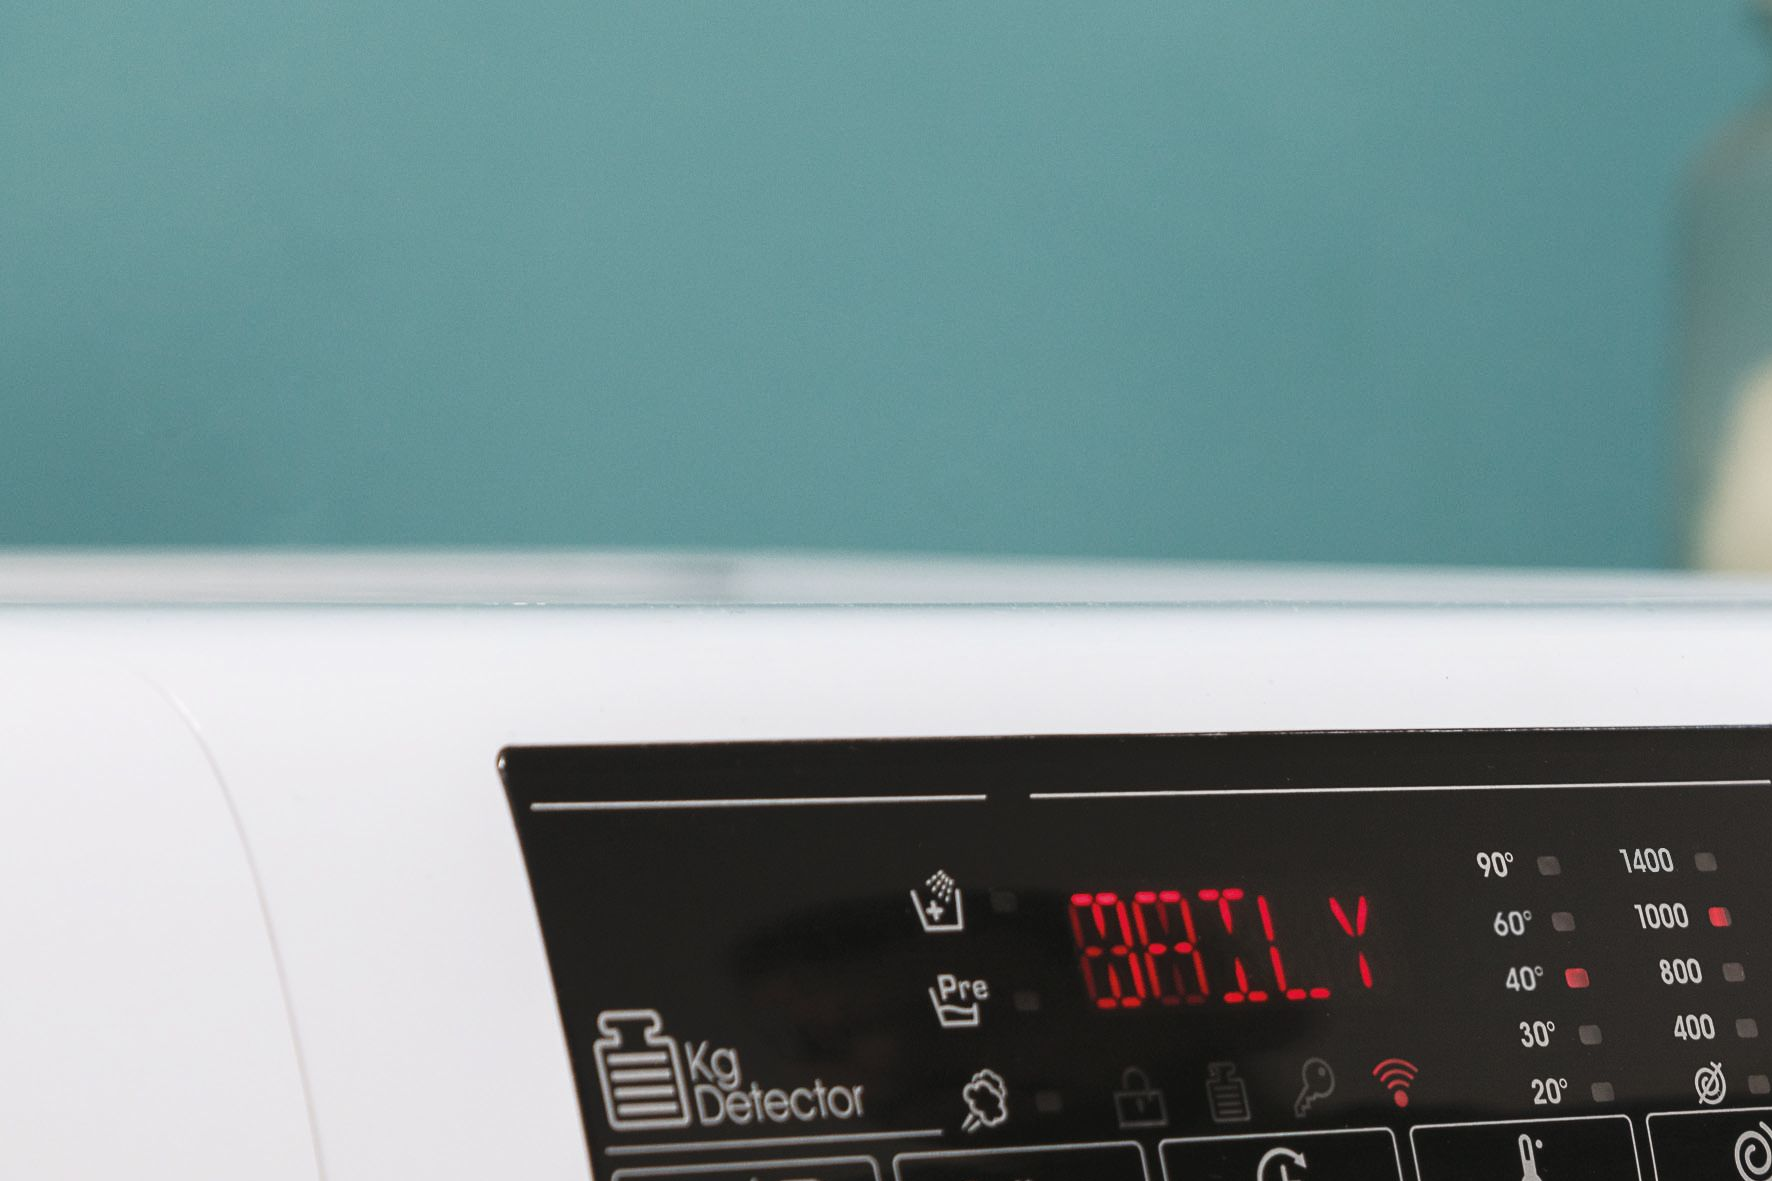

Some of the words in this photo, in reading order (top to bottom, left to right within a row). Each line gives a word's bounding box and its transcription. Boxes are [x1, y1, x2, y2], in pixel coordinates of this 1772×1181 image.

[1476, 851, 1513, 878] 90°
[1618, 847, 1675, 873] 1400
[1493, 909, 1532, 936] 60°
[1633, 902, 1689, 929] 1000
[1505, 965, 1544, 992] 40°
[1658, 958, 1703, 985] 800
[936, 973, 989, 1001] Pre
[1519, 1020, 1556, 1048] 30°
[1673, 1013, 1716, 1041] 400
[685, 1040, 741, 1087] Kg
[694, 1079, 865, 1127] Detector
[1530, 1077, 1568, 1105] 20°
